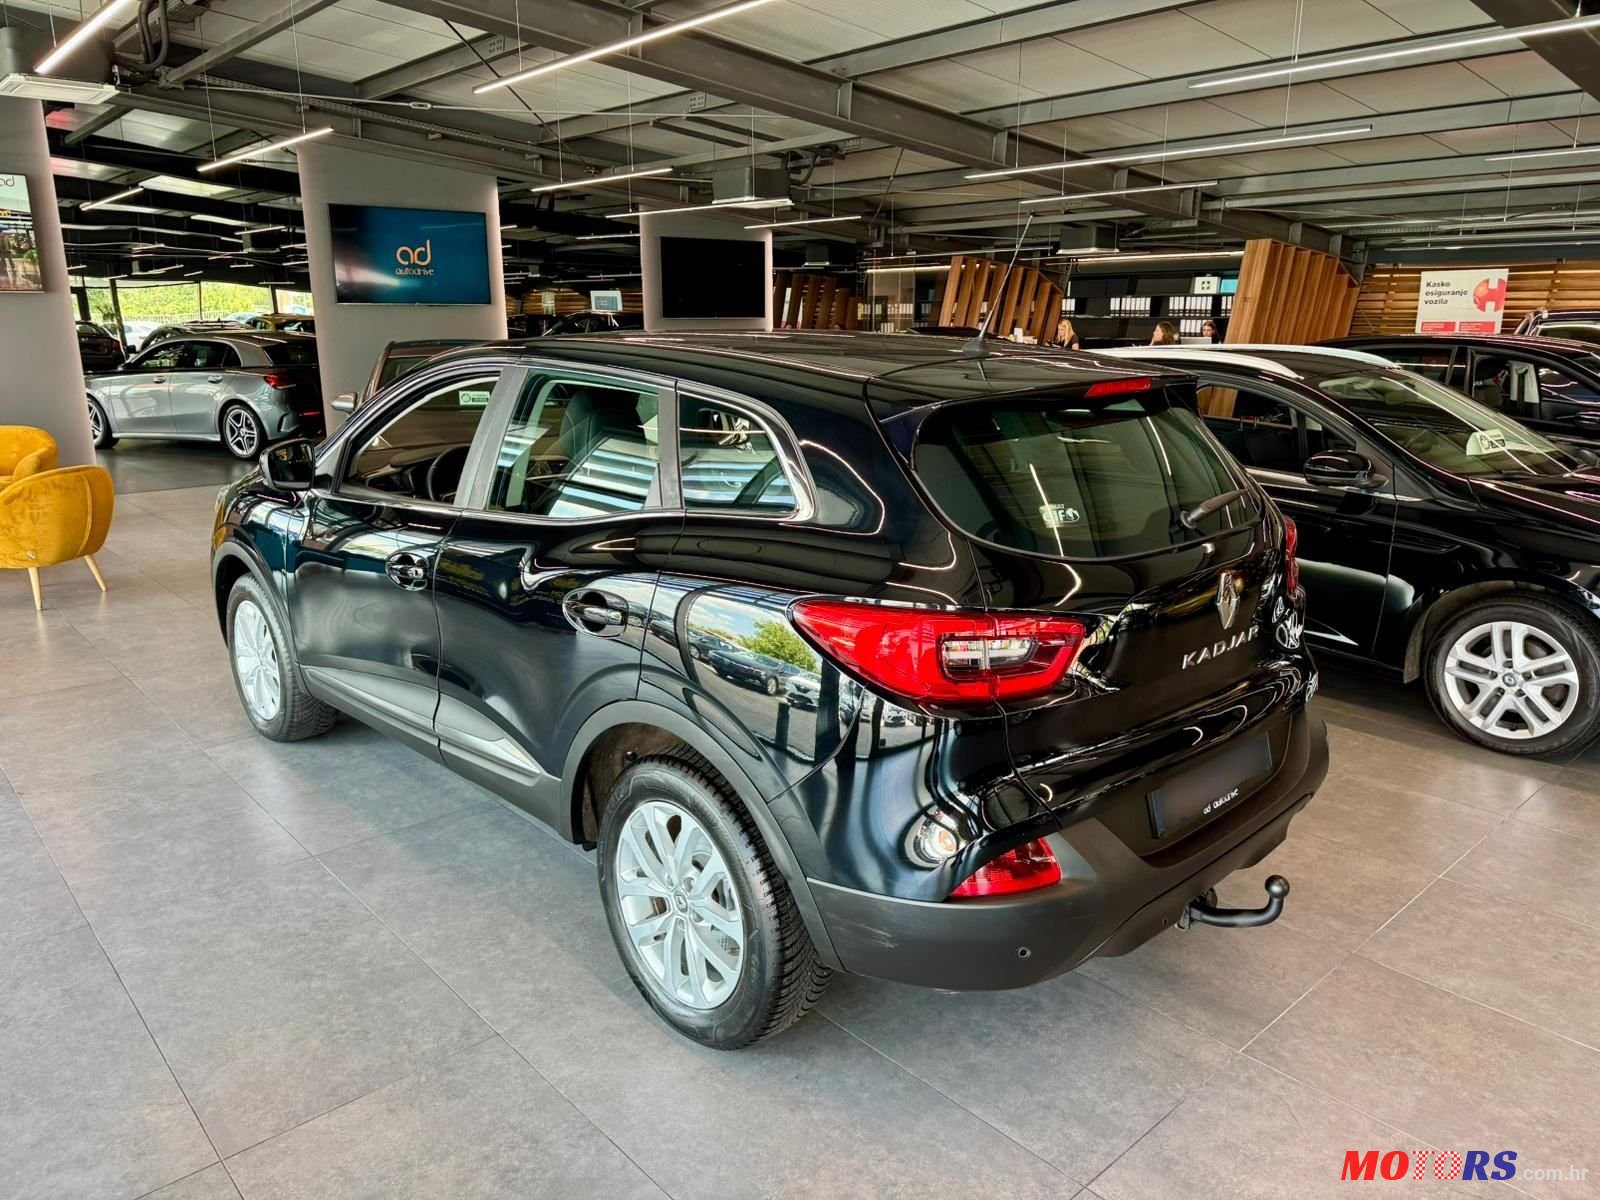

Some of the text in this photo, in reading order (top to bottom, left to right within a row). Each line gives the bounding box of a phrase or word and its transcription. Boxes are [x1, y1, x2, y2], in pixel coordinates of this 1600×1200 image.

[396, 239, 432, 266] ad
[1425, 288, 1468, 297] osiguranje
[1182, 625, 1259, 669] KADJAR
